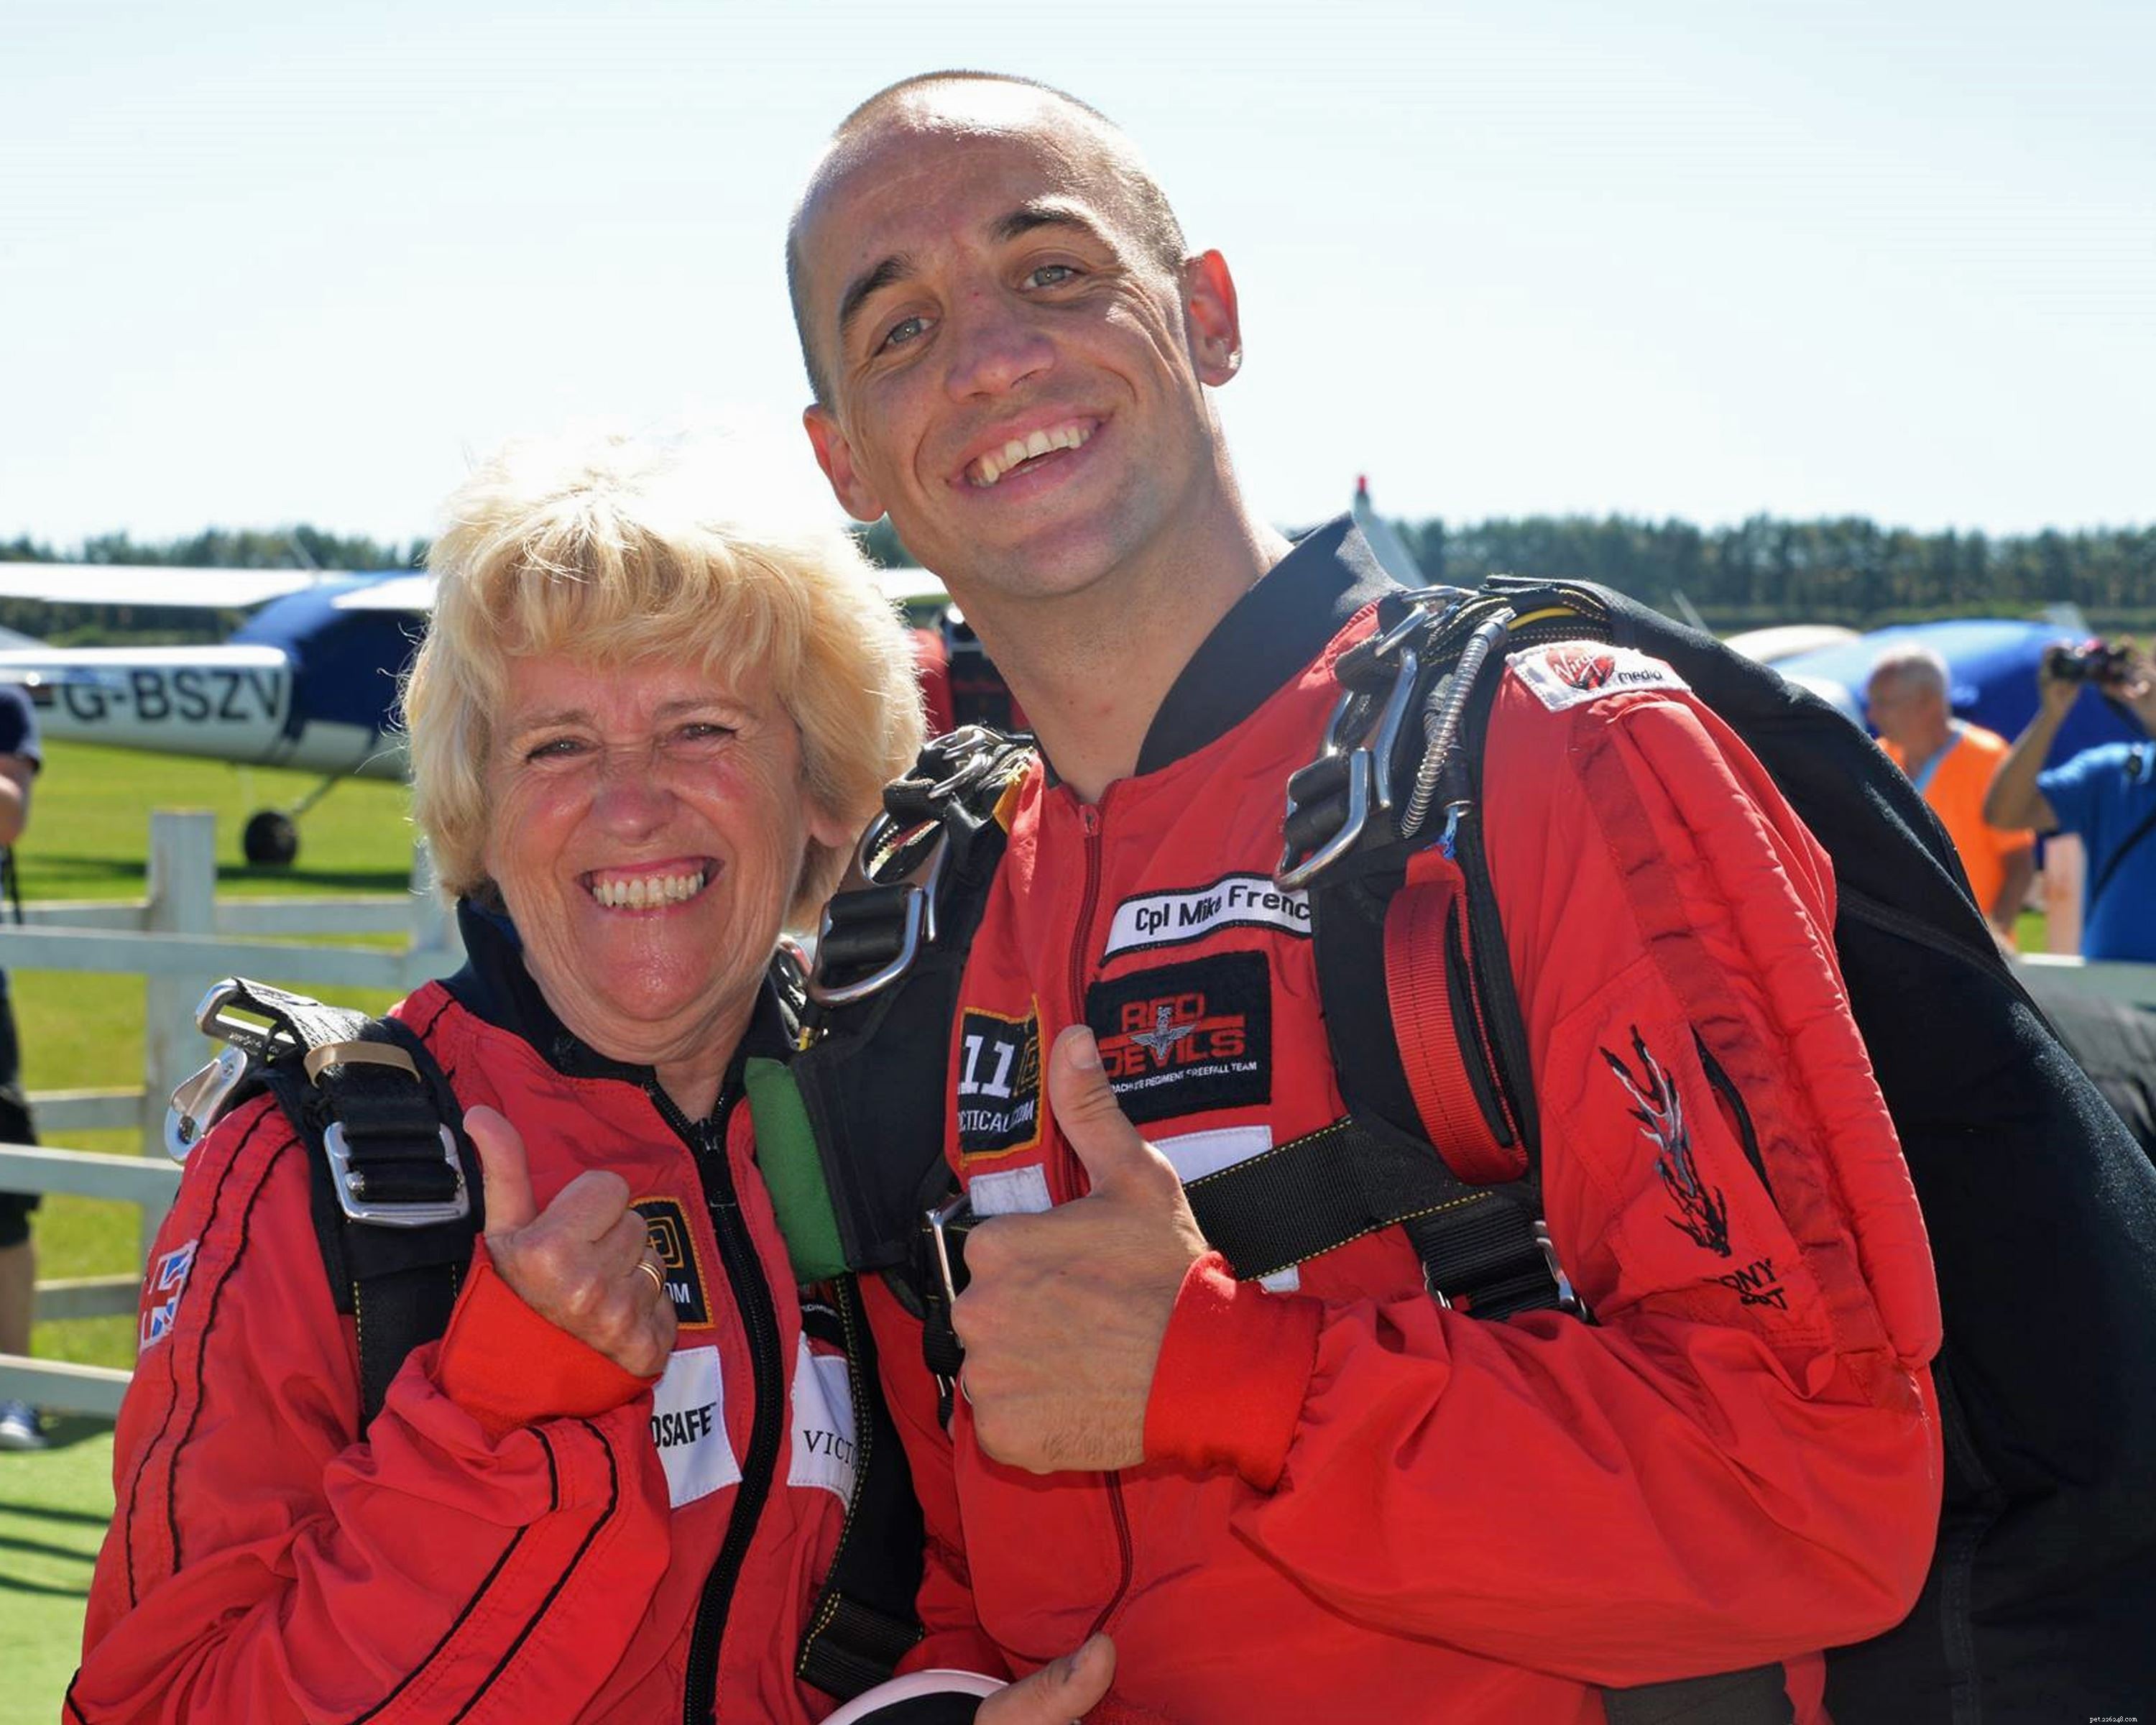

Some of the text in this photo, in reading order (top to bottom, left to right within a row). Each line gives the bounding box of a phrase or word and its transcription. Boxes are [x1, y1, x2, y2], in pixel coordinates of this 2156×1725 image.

[65, 666, 281, 722] G-BSZV
[1135, 903, 1170, 935] Cpl
[1179, 896, 1222, 926] Mike
[1231, 1061, 1258, 1072] TEAM
